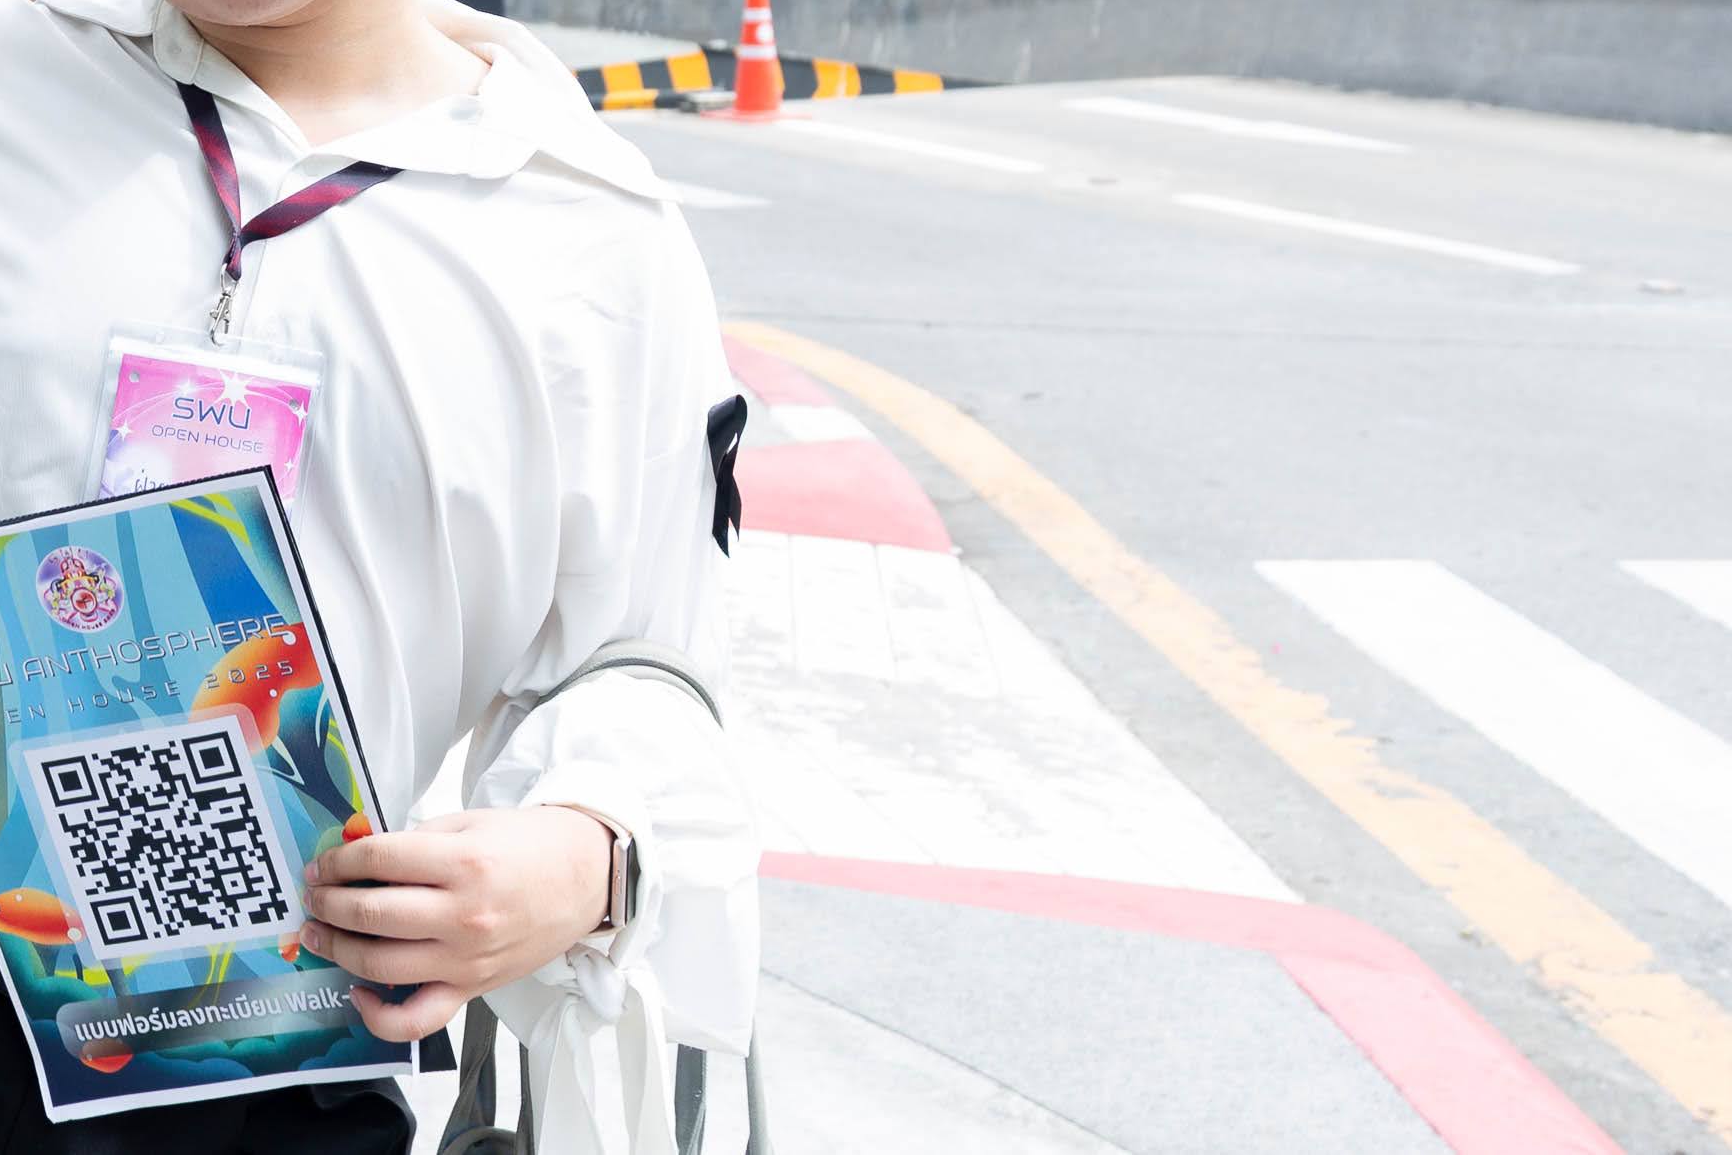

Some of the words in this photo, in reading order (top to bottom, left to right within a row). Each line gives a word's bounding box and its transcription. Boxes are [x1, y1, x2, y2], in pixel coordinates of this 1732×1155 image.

[151, 424, 200, 444] OPEN
[204, 433, 264, 454] HOUSE
[172, 397, 251, 430] SWU
[23, 613, 289, 682] ANTHOSPHERE
[67, 680, 181, 713] HOUSE
[203, 660, 295, 691] 2025
[74, 993, 282, 1043] แบบฟอร์มลงทะเบียน
[283, 984, 356, 1015] Walk-
